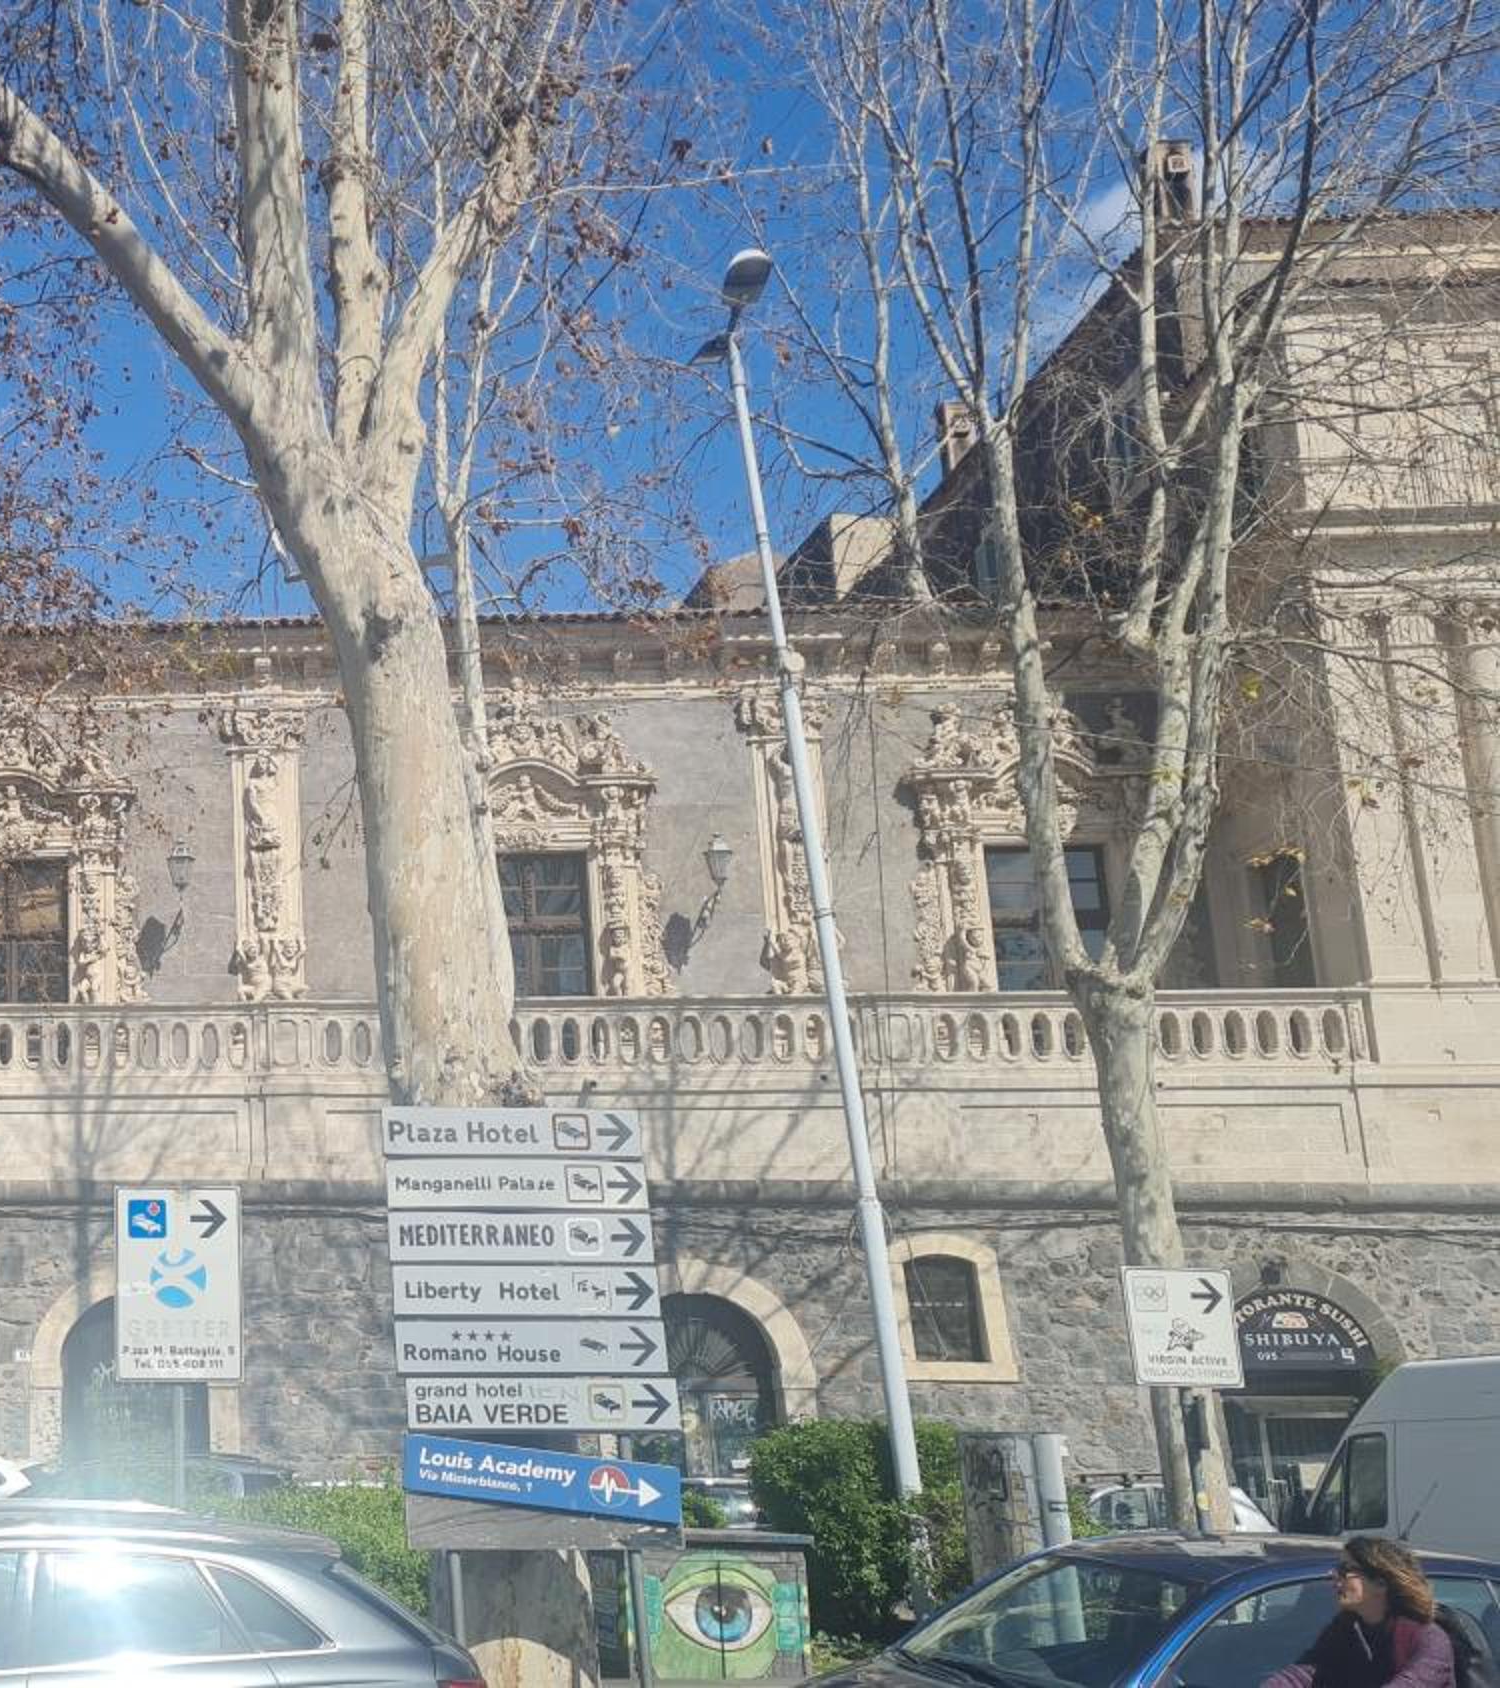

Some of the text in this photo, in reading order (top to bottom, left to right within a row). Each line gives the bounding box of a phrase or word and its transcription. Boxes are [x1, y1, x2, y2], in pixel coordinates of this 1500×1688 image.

[388, 1120, 539, 1144] Plaza Hotel
[395, 1175, 491, 1194] Manganelli
[399, 1223, 555, 1247] MEDITERRANEO
[404, 1280, 561, 1303] Liberty Hotel
[1233, 1293, 1369, 1348] TORANTE SUSHI
[1243, 1332, 1340, 1346] SHIBUYA
[403, 1343, 561, 1364] Romano House
[414, 1383, 468, 1401] grand
[475, 1382, 523, 1398] hotel
[416, 1403, 569, 1425] BAIA VERDE
[419, 1447, 577, 1488] Louis Academy
[419, 1467, 439, 1482] Via
